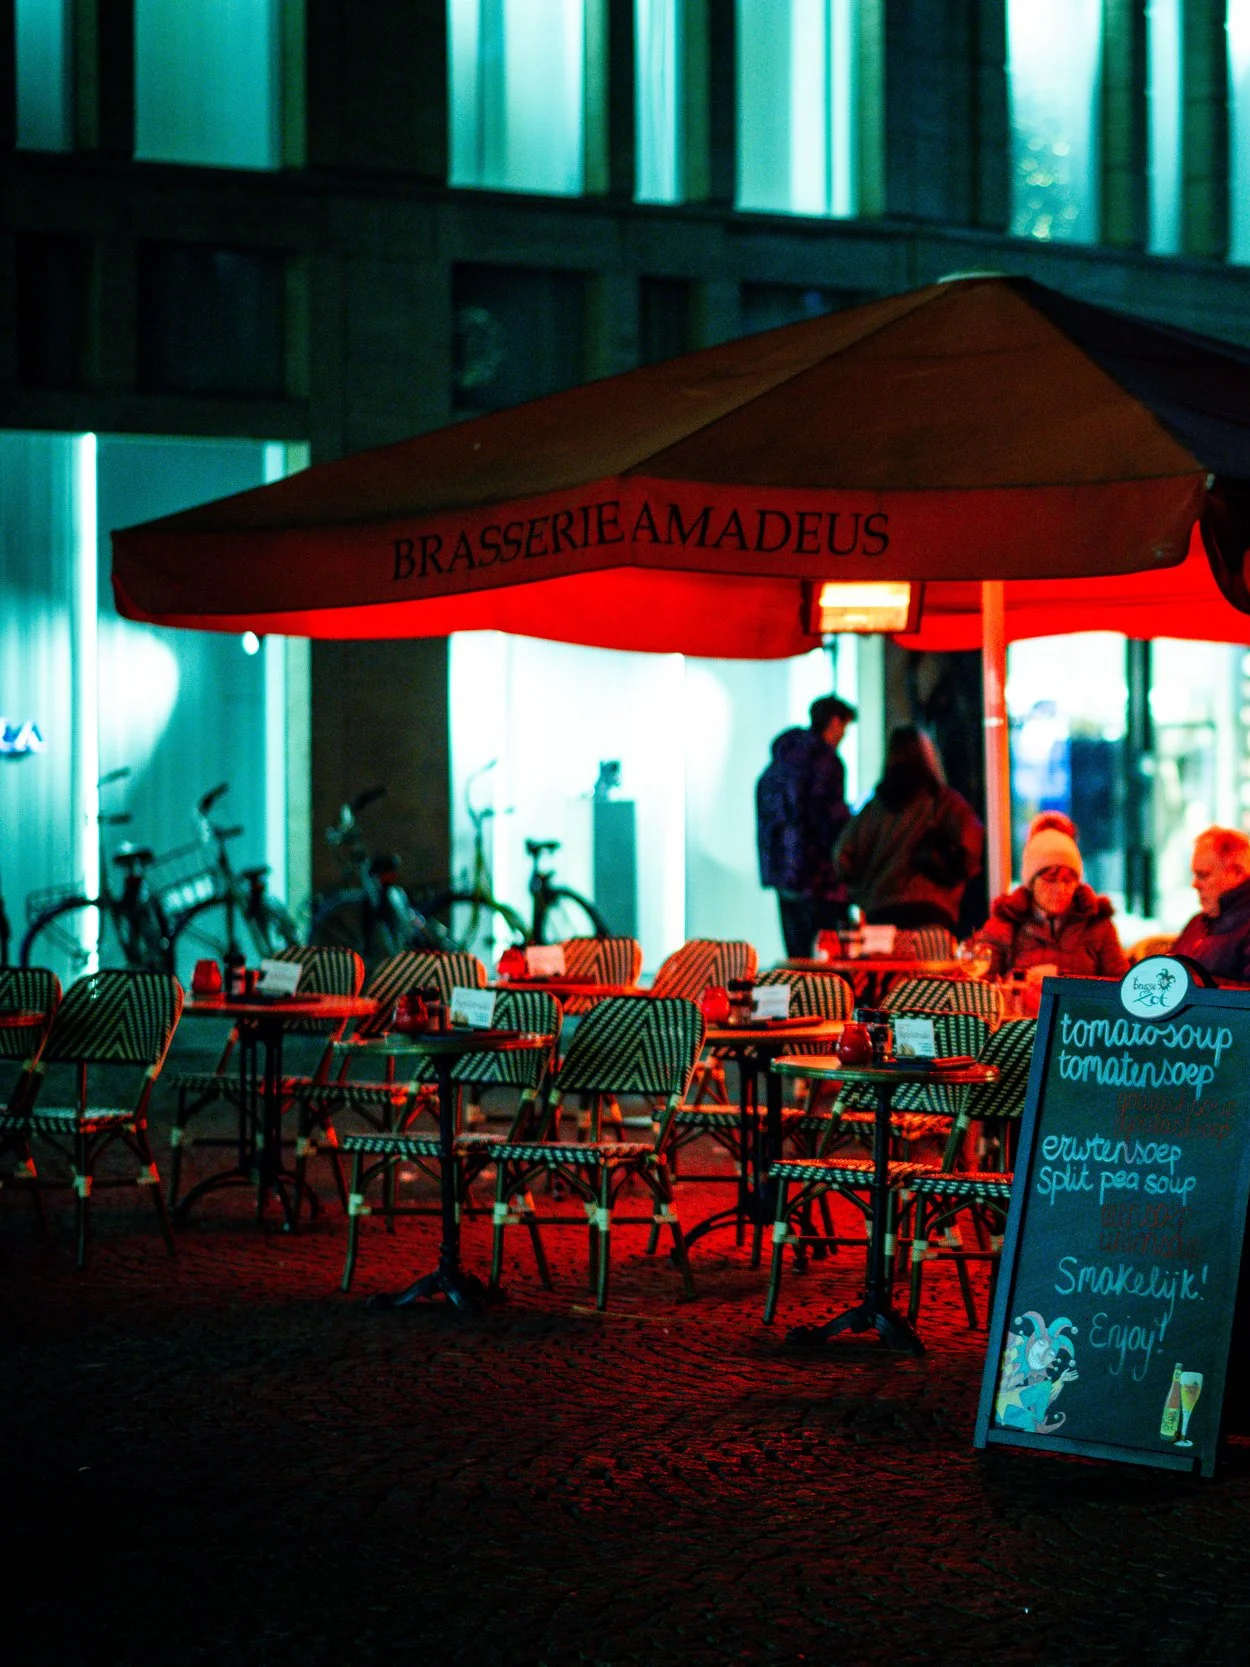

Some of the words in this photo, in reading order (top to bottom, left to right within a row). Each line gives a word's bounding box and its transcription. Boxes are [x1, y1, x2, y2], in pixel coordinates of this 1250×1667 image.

[392, 500, 625, 582] BRASSERIE
[631, 499, 890, 557] AMADEUS
[1132, 990, 1170, 1008] Zot
[1099, 1171, 1139, 1205] pea
[1144, 1173, 1197, 1206] soup
[1089, 1311, 1168, 1382] Enjoy!
